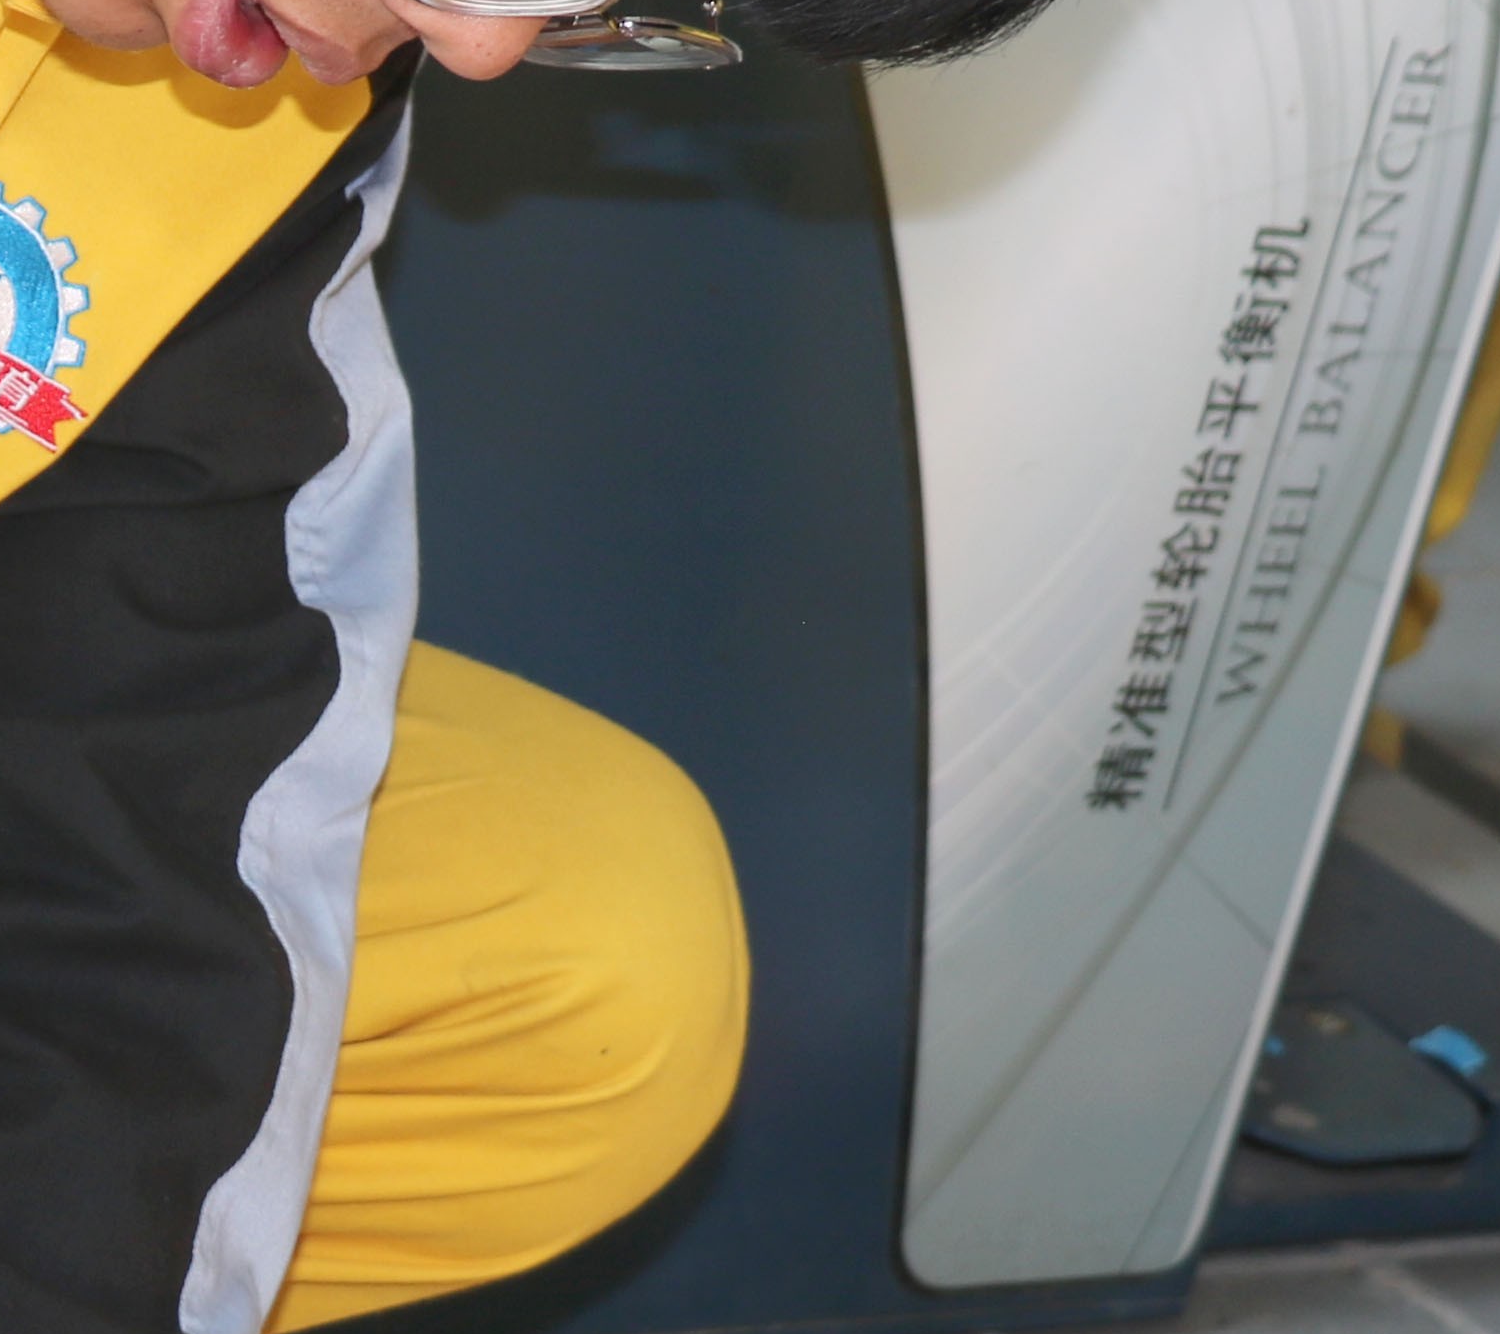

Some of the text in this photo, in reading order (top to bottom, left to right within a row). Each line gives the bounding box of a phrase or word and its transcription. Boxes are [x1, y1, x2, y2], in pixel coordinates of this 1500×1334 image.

[1086, 214, 1310, 814] 精准型轮胎平衡机
[1215, 40, 1452, 707] WHEEL BALANCER
